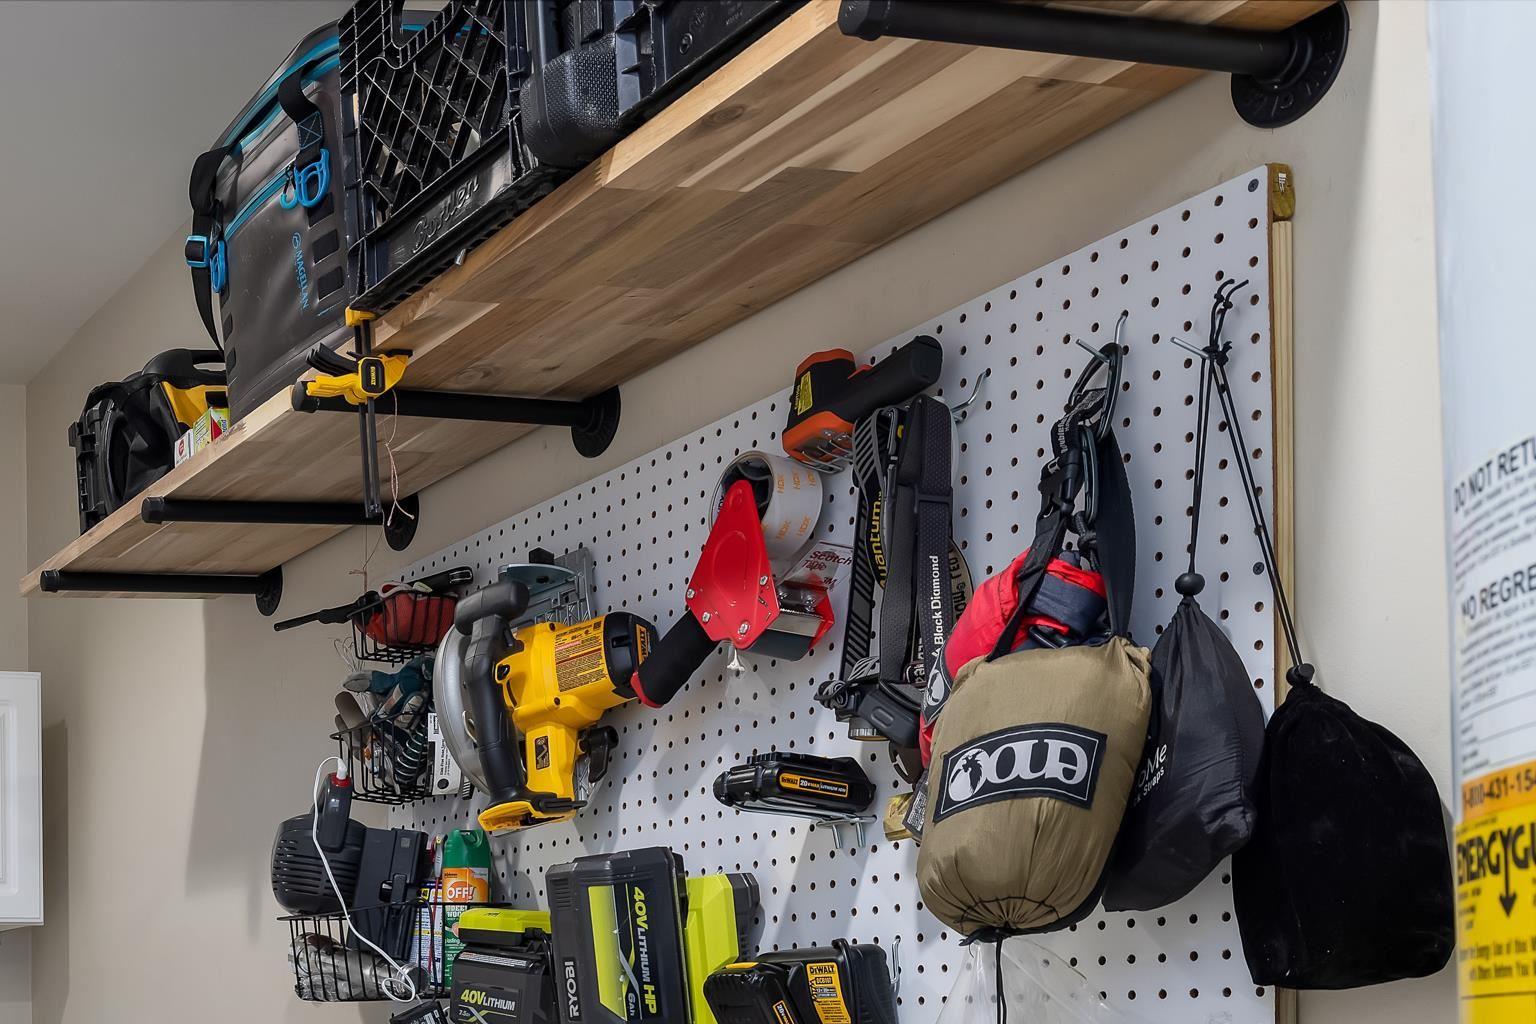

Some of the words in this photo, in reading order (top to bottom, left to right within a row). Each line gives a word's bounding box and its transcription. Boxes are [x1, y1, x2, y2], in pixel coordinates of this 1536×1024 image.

[296, 249, 309, 310] MAGELLAN
[1453, 480, 1467, 513] DO
[1468, 460, 1493, 497] NOT
[803, 560, 827, 571] Tape
[809, 550, 852, 566] Scotch
[929, 555, 942, 609] Diamond
[931, 609, 944, 646] Black
[1143, 766, 1165, 796] Straps
[446, 885, 474, 900] OFF!
[633, 886, 649, 930] 40V
[637, 927, 651, 982] LITHIUM
[809, 965, 836, 975] DEWALT
[460, 989, 486, 1005] 40V
[482, 996, 516, 1011] LITHIUM
[565, 961, 579, 1018] RYOBI
[628, 992, 636, 1017] 6Ah
[643, 984, 658, 1014] HP
